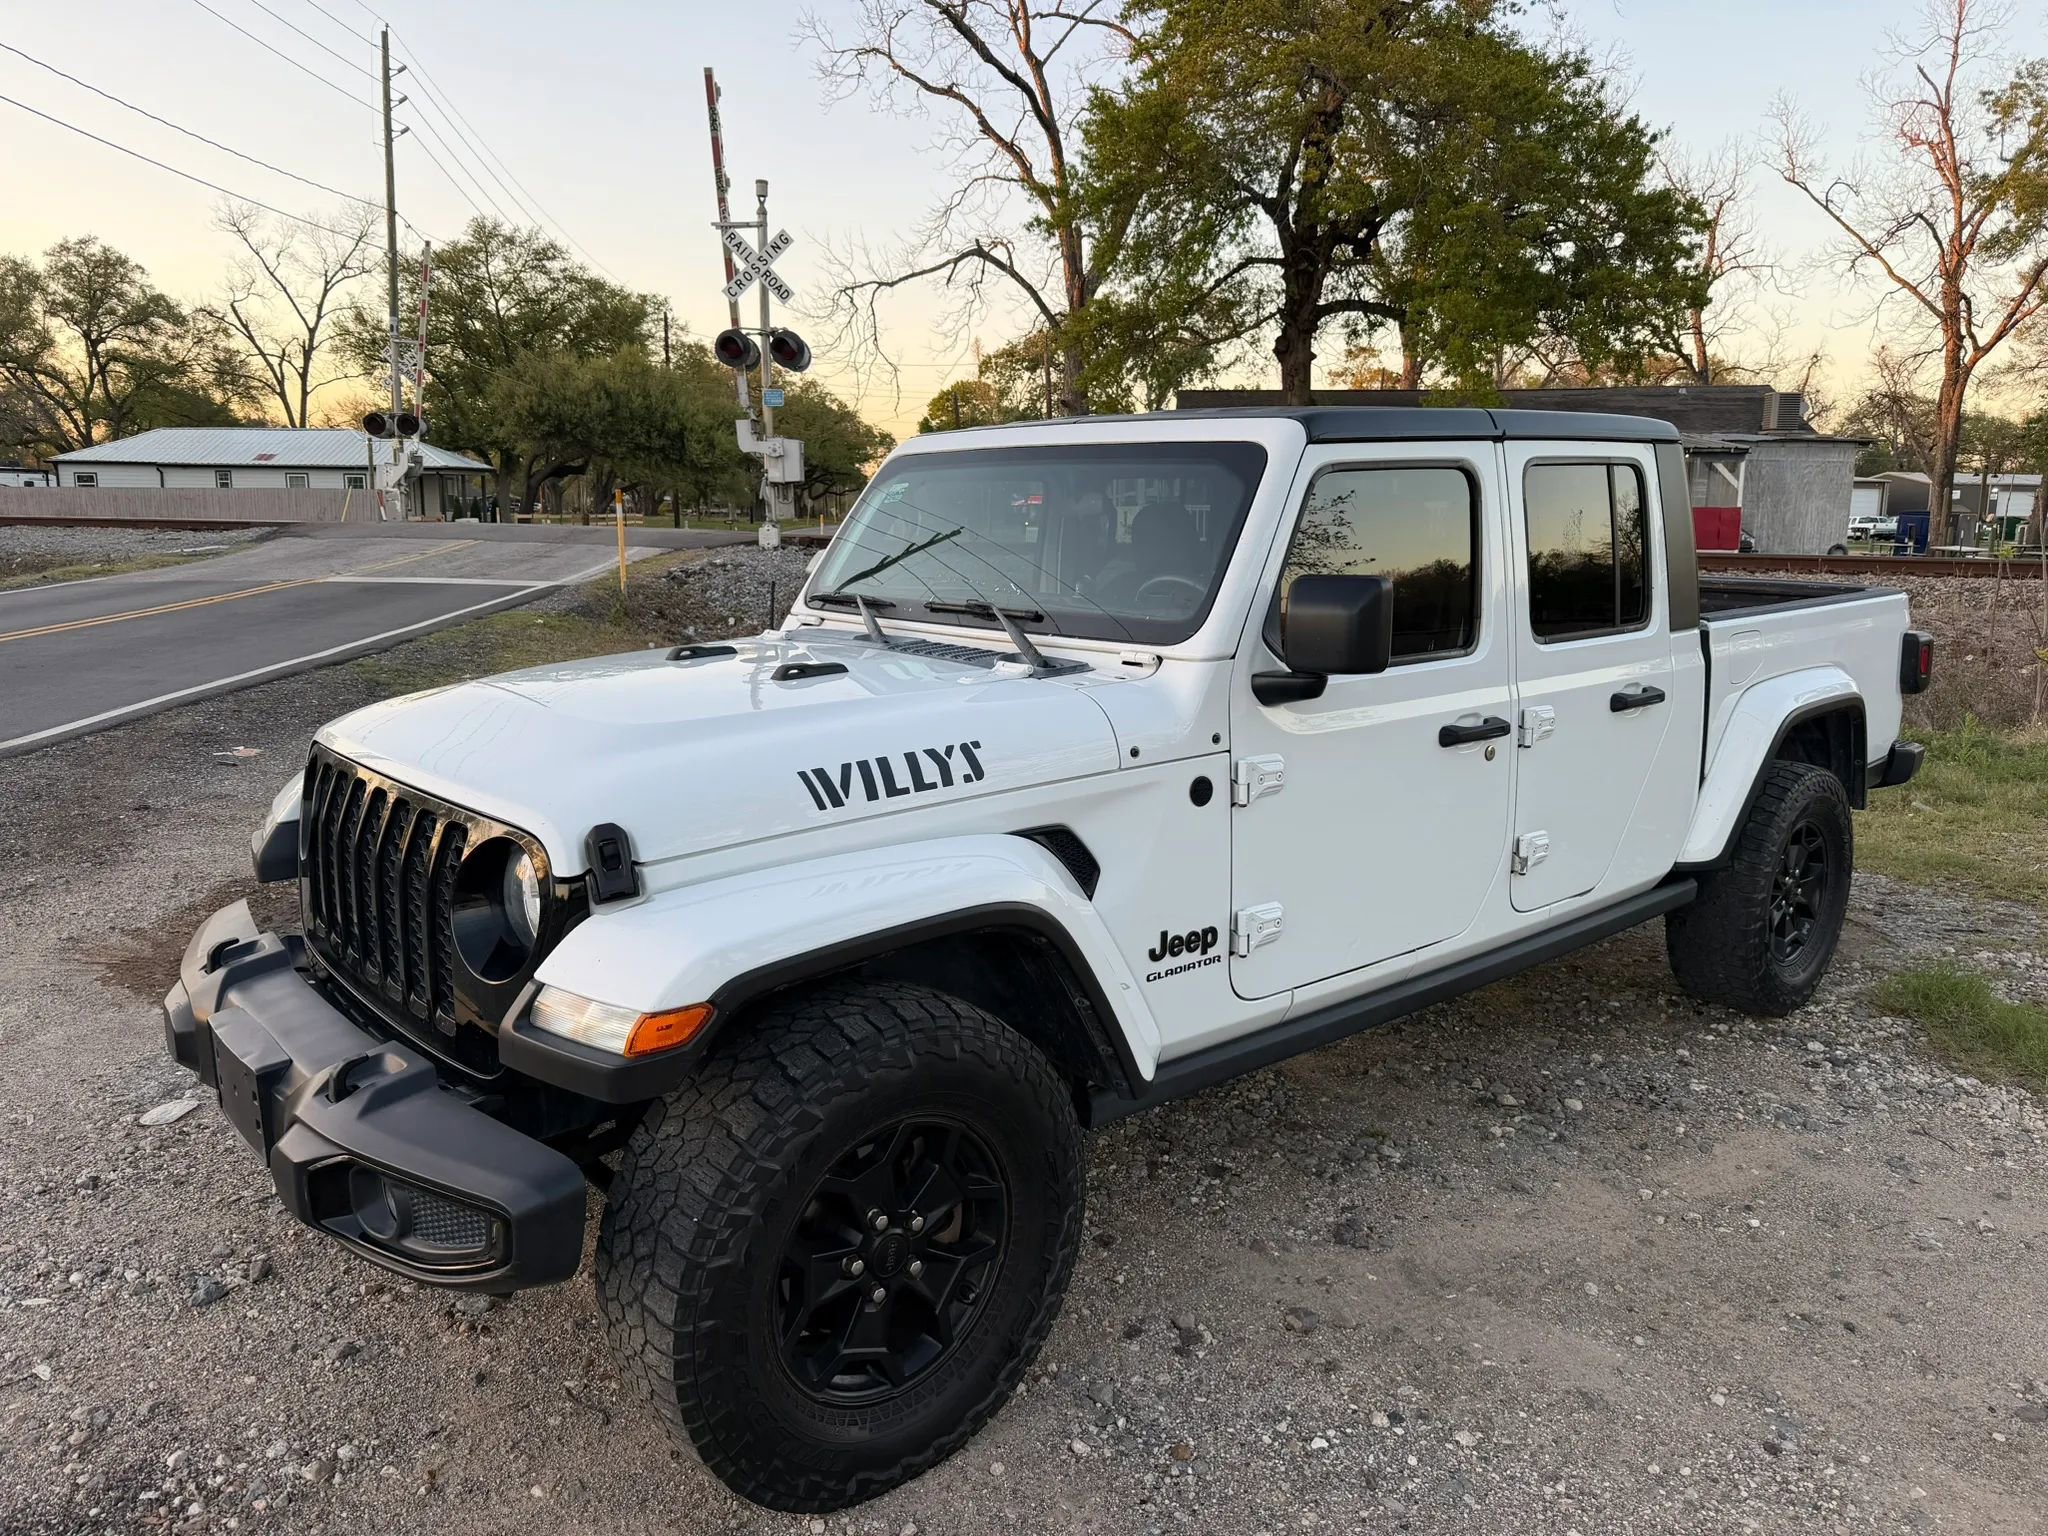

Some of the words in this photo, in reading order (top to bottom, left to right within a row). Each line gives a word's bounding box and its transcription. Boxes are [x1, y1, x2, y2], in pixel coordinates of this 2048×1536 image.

[725, 232, 751, 263] RAIL
[761, 269, 790, 300] ROAD
[727, 233, 789, 298] CROSSING
[797, 740, 985, 811] WILLYS
[1146, 955, 1221, 983] GLADIATOR
[1148, 925, 1218, 962] Jeep
